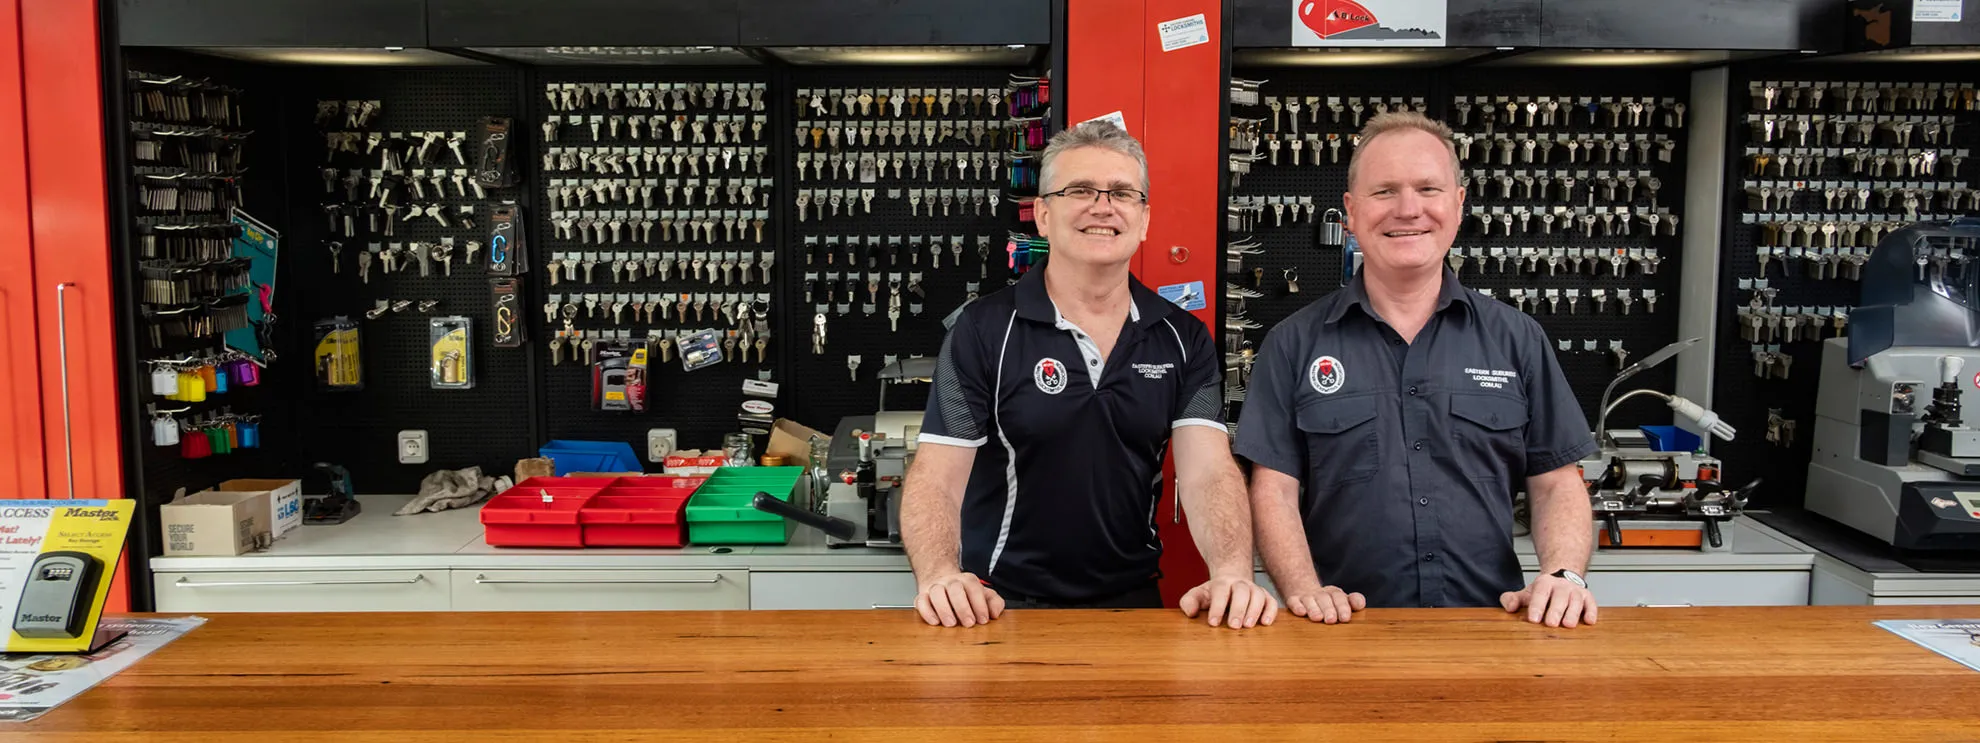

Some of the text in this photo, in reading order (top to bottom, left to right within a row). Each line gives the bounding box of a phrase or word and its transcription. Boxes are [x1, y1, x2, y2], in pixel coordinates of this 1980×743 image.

[1350, 13, 1370, 22] Lock
[64, 508, 119, 518] Master
[168, 524, 195, 533] SECURE
[6, 536, 42, 547] Lately?
[169, 533, 188, 541] YOUR
[170, 542, 194, 551] WORLD
[21, 613, 62, 622] Master
